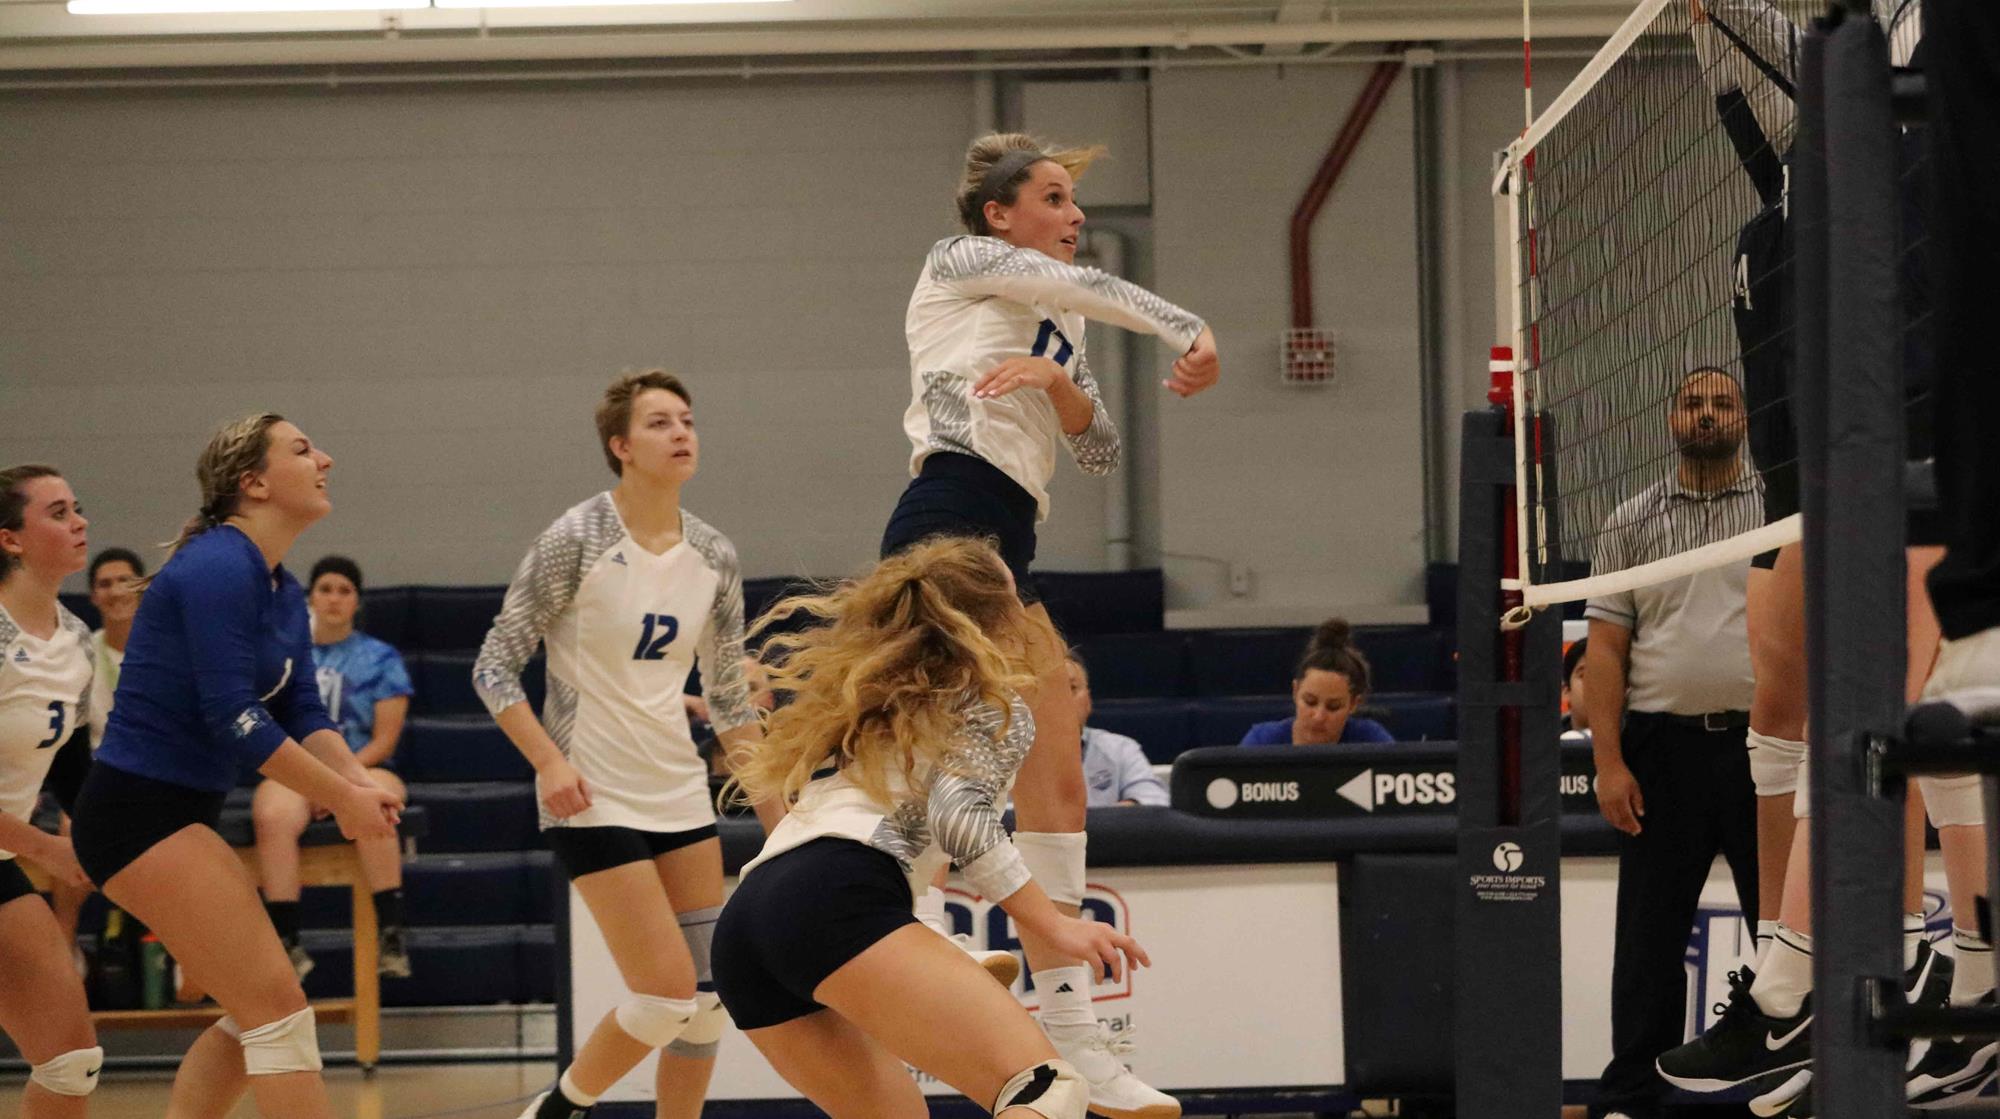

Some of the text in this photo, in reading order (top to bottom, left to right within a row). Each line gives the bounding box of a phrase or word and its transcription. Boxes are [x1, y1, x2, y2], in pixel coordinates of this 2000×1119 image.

[632, 613, 679, 660] 12
[36, 700, 65, 749] 3
[1241, 782, 1300, 802] BONUS
[1375, 772, 1456, 805] POSS
[1470, 875, 1504, 885] SPORTS
[1504, 875, 1546, 887] IMPORTS
